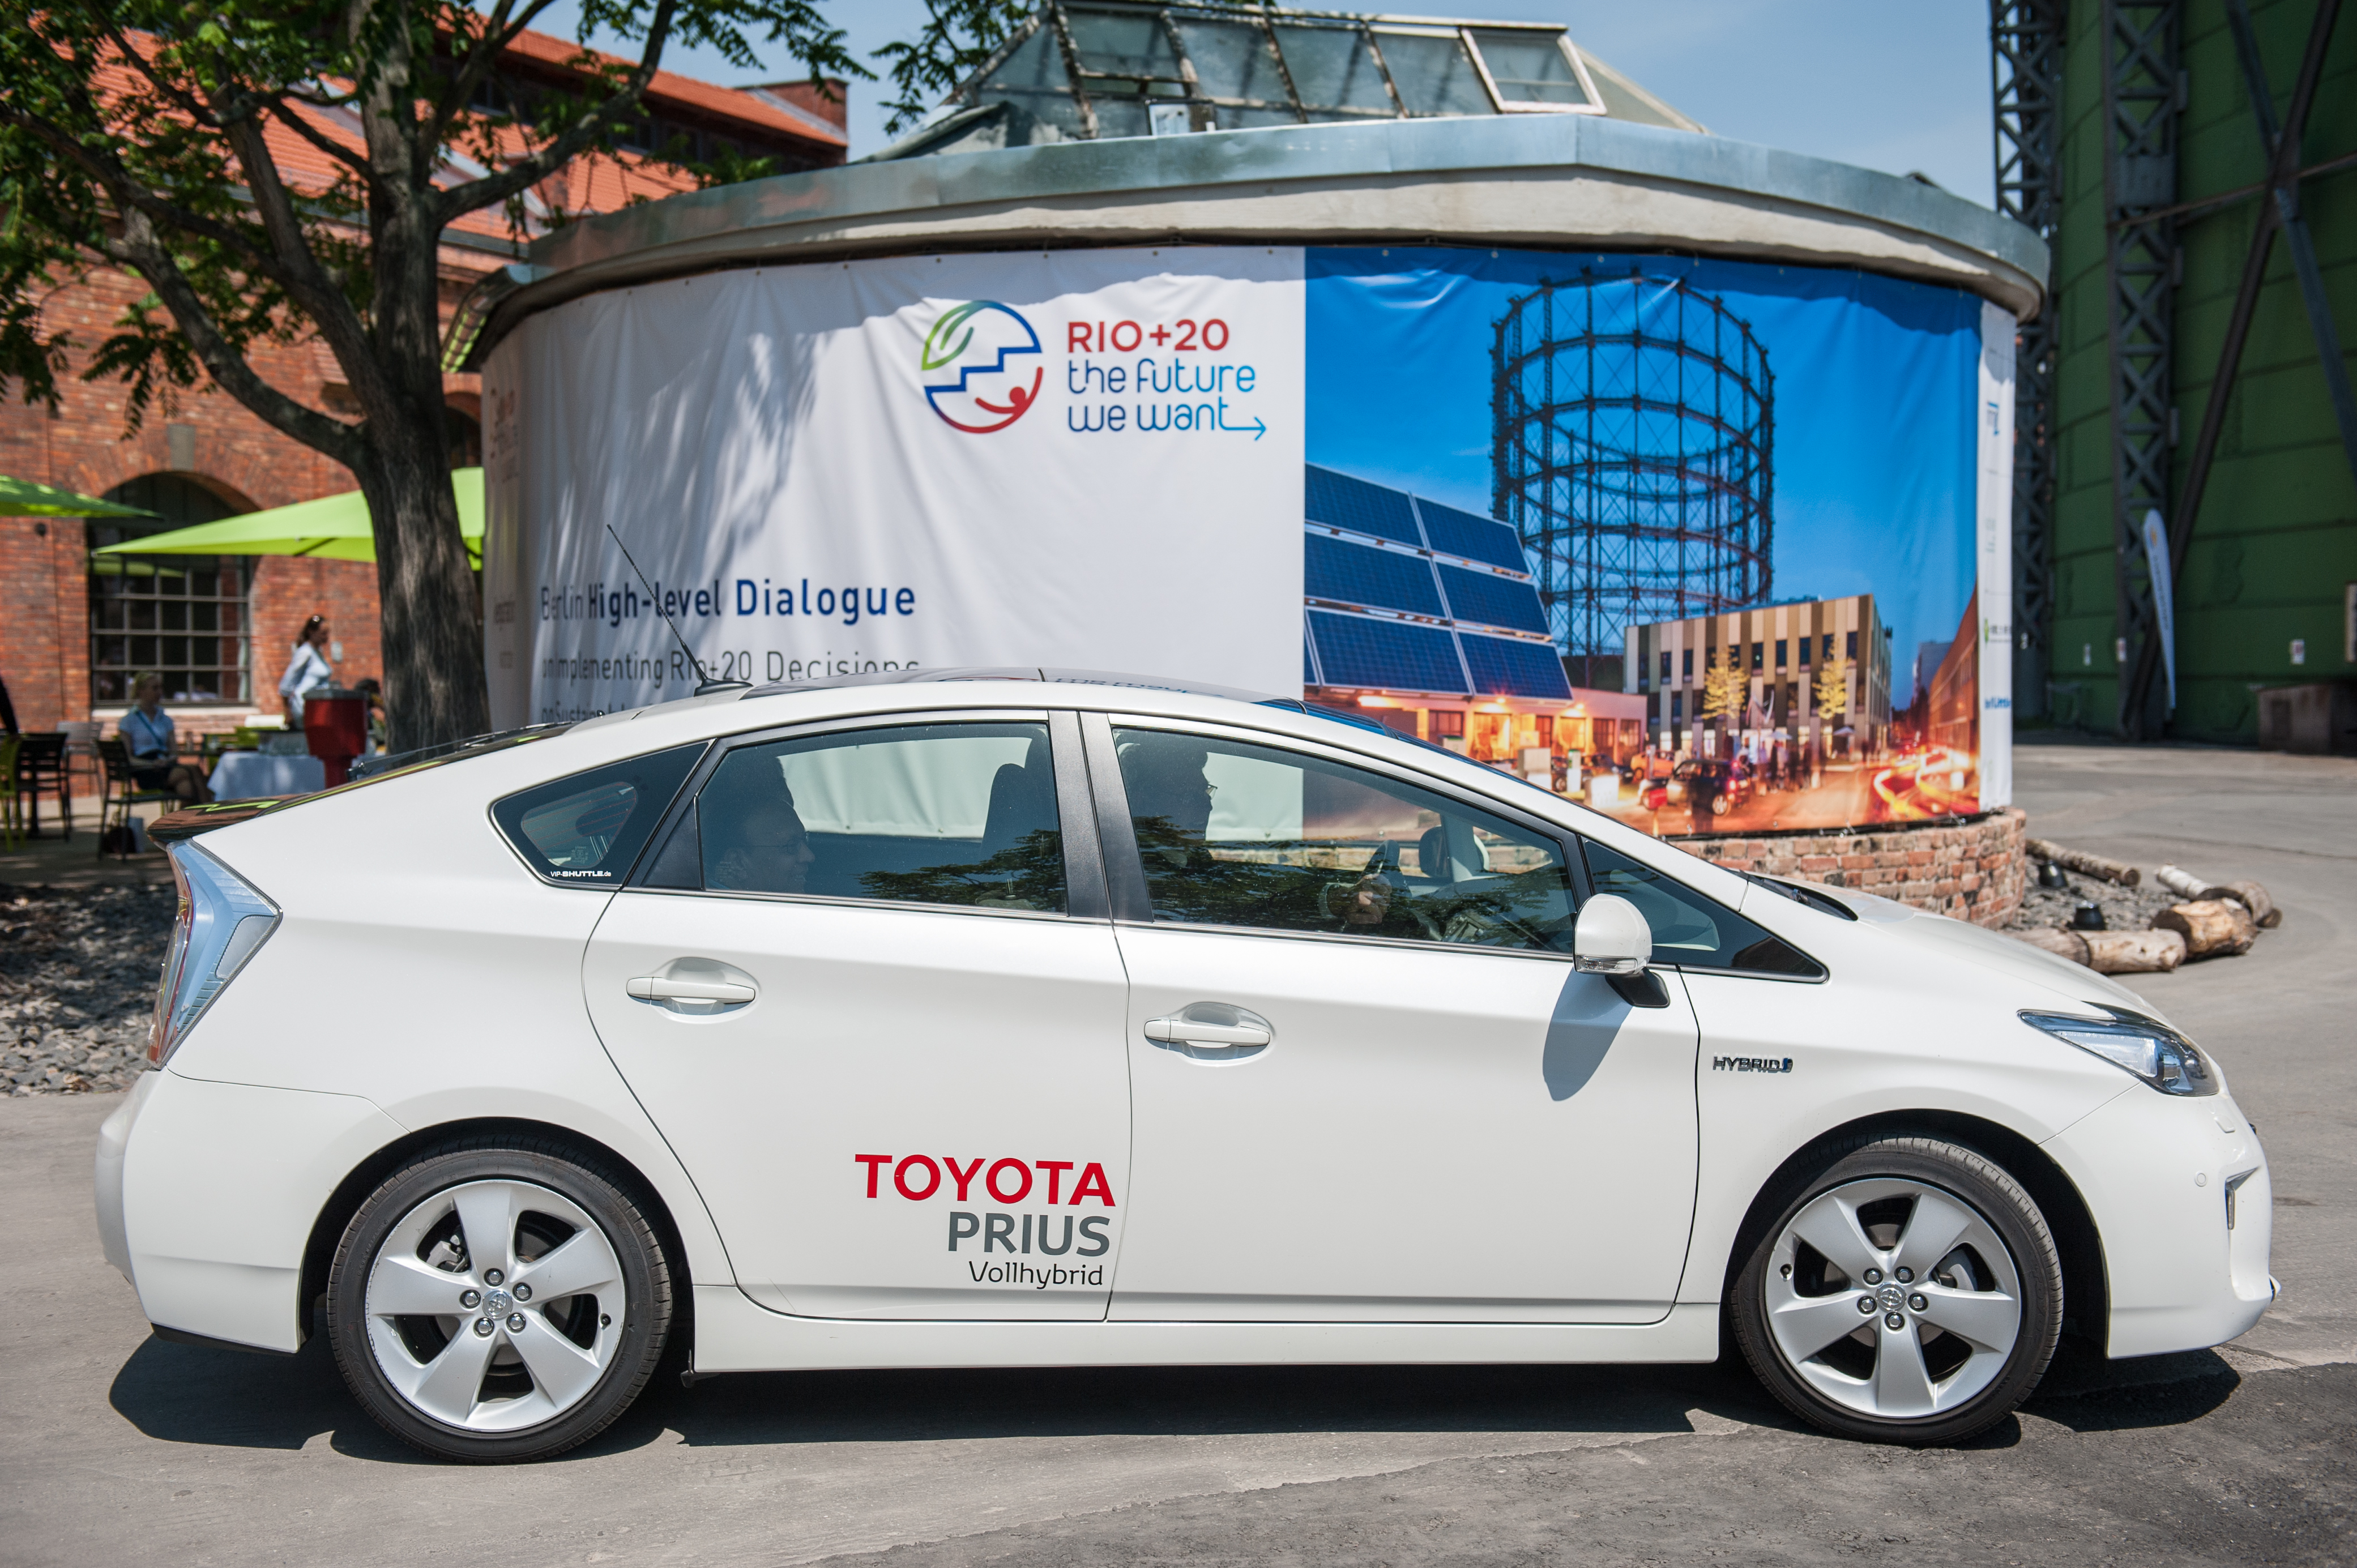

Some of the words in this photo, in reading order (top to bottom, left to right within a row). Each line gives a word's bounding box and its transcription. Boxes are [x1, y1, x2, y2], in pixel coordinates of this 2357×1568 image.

[1068, 318, 1229, 353] RIO+20
[1069, 359, 1126, 394] the
[1137, 357, 1256, 394] future
[1069, 404, 1126, 432] we
[1137, 396, 1266, 433] want
[541, 584, 583, 620] Berlin
[589, 579, 721, 627] High-level
[736, 578, 915, 626] Dialogue
[1712, 1056, 1780, 1073] HYBRID
[855, 1153, 1116, 1207] TOYOTA
[947, 1211, 1111, 1257] PRIUS
[968, 1260, 1103, 1290] Vollhybrid
